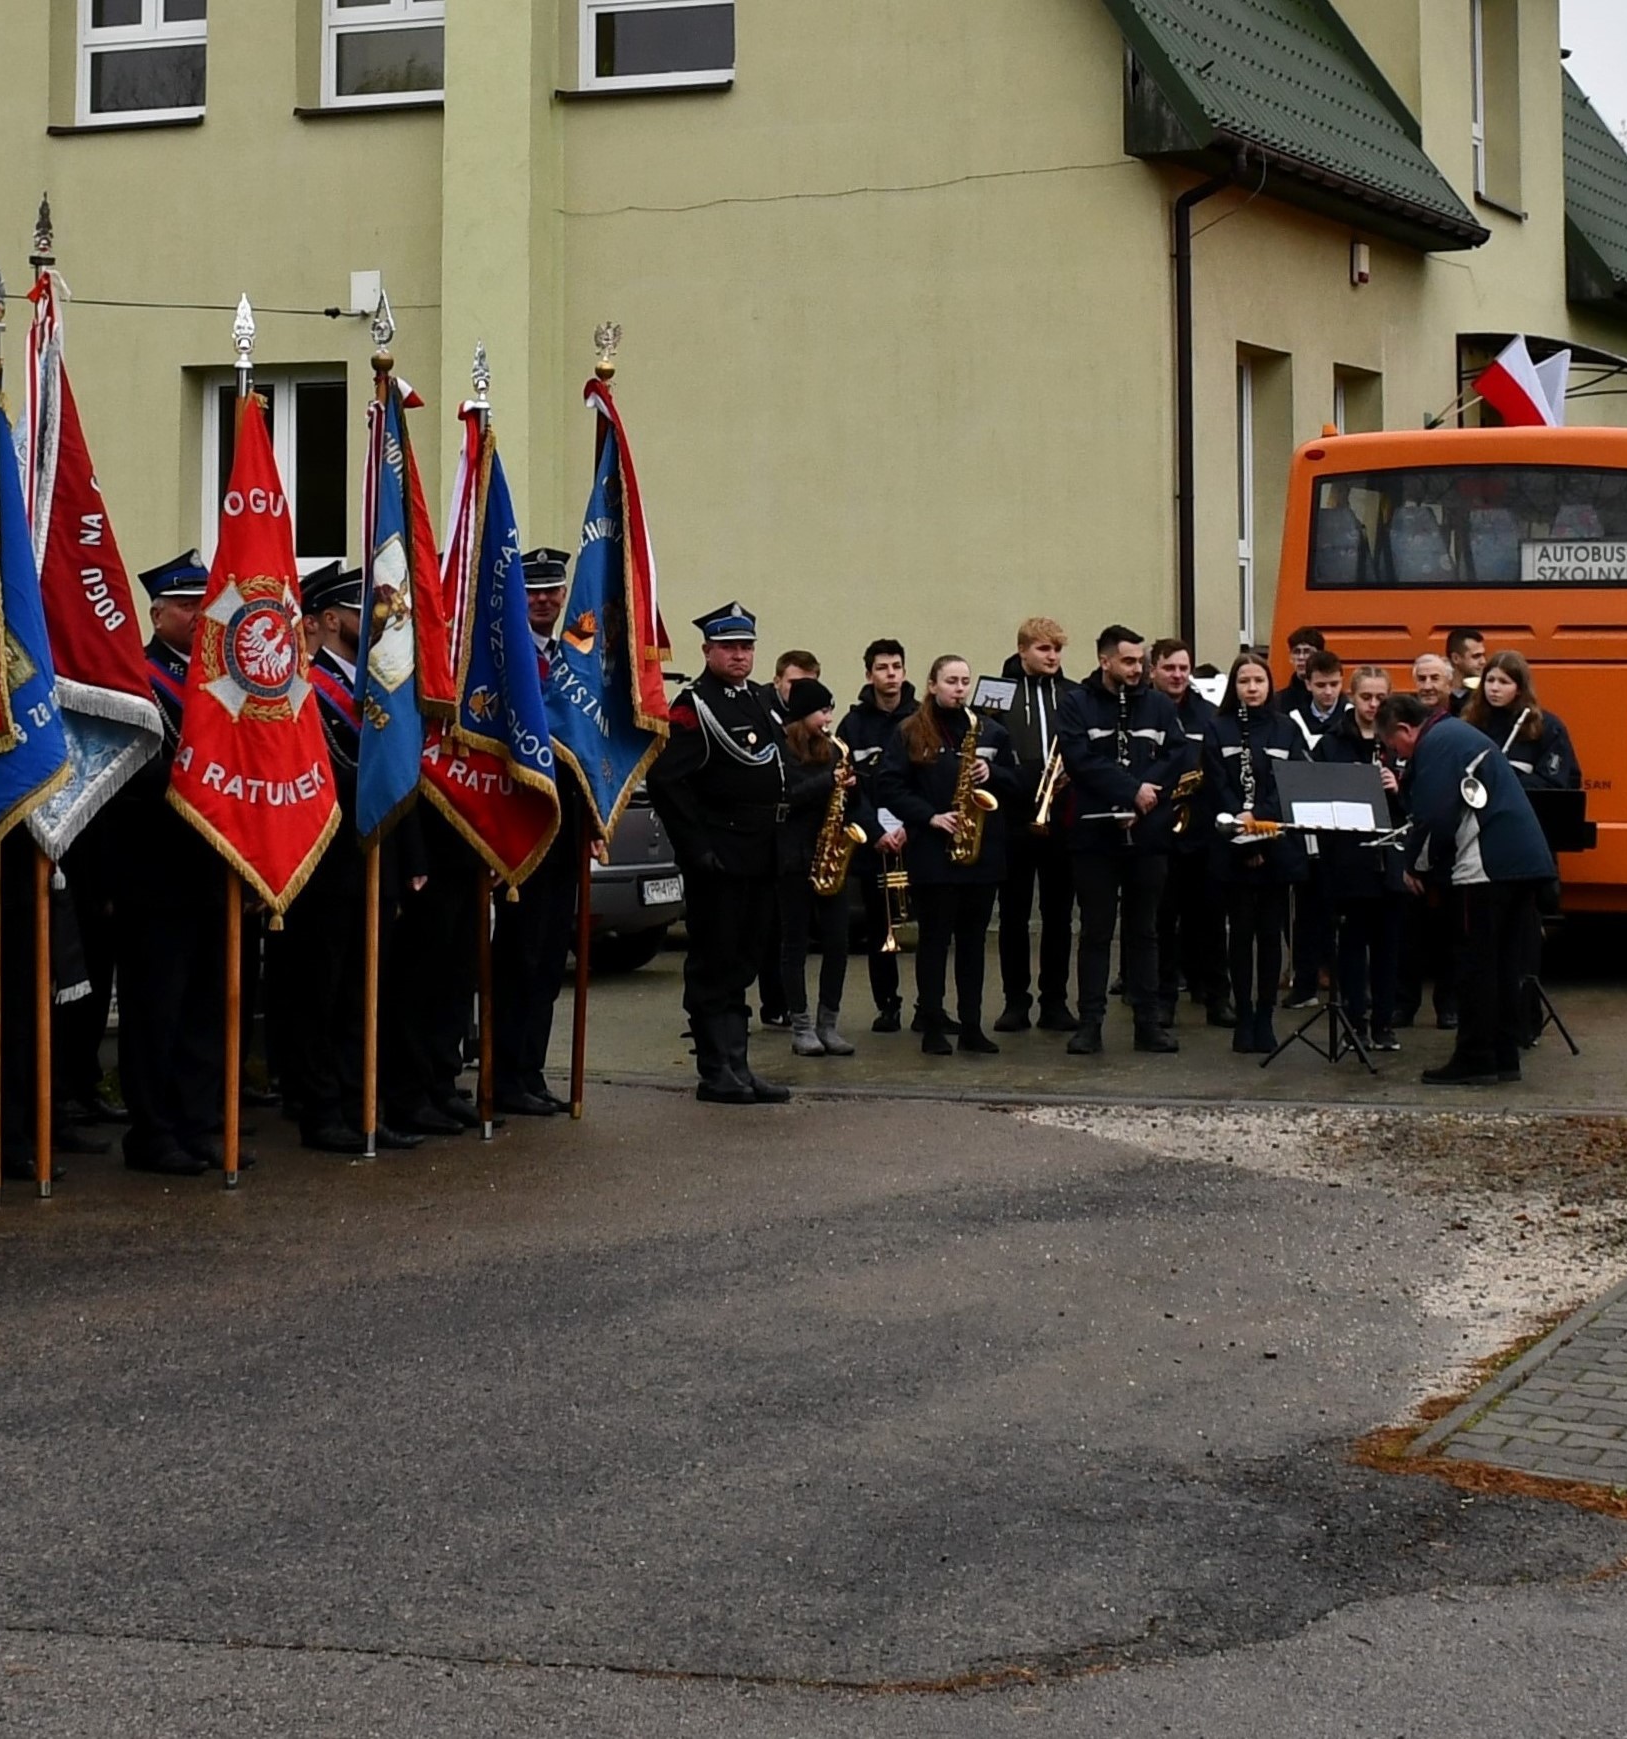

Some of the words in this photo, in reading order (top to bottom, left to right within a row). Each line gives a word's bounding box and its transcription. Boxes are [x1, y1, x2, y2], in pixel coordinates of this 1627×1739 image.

[224, 487, 288, 517] OGU
[79, 513, 103, 546] NA
[1538, 545, 1627, 563] AUTOBUS
[1537, 566, 1626, 580] SZKOLNY
[80, 567, 126, 632] BOGU
[201, 761, 327, 806] RATUNEK
[447, 758, 514, 796] RATU
[1584, 780, 1612, 790] SAN
